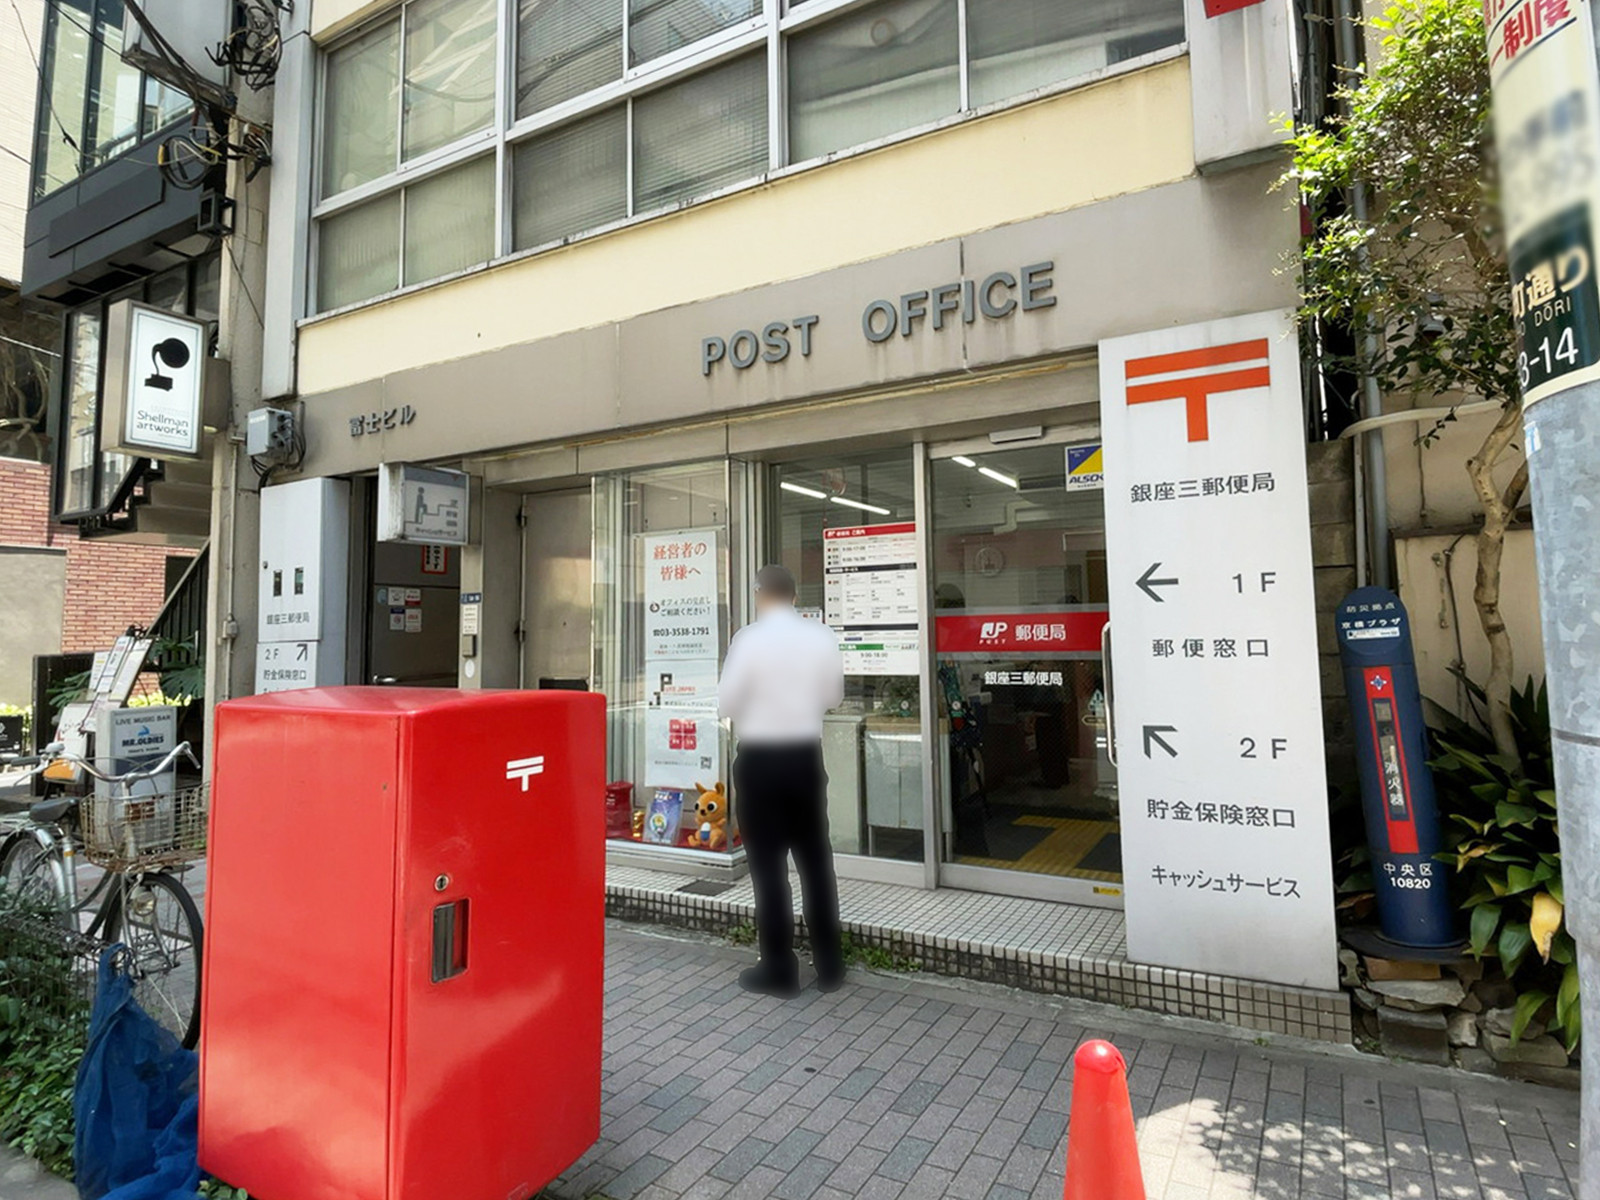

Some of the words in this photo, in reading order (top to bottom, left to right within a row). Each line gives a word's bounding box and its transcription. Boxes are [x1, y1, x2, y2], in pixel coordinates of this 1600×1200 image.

[702, 315, 819, 376] POST
[862, 261, 1058, 343] OFFICE
[137, 410, 189, 427] Shellman
[349, 404, 417, 437] 富士ビル
[136, 422, 188, 436] artworks
[1130, 472, 1275, 503] 銀座三郵便局
[654, 542, 707, 560] 経営者の
[661, 564, 701, 581] 皆様へ
[1346, 602, 1396, 614] 防災拠点
[1341, 617, 1402, 630] 京橋プラザ
[1015, 624, 1067, 641] 郵便局
[1152, 637, 1269, 658] 郵便窓口
[984, 671, 1063, 687] 銀座三郵便局
[1147, 799, 1295, 828] 貯金保険窓口
[1383, 862, 1433, 876] 中央区
[1151, 865, 1301, 898] キャッシュサービス
[1390, 876, 1431, 889] 10820
